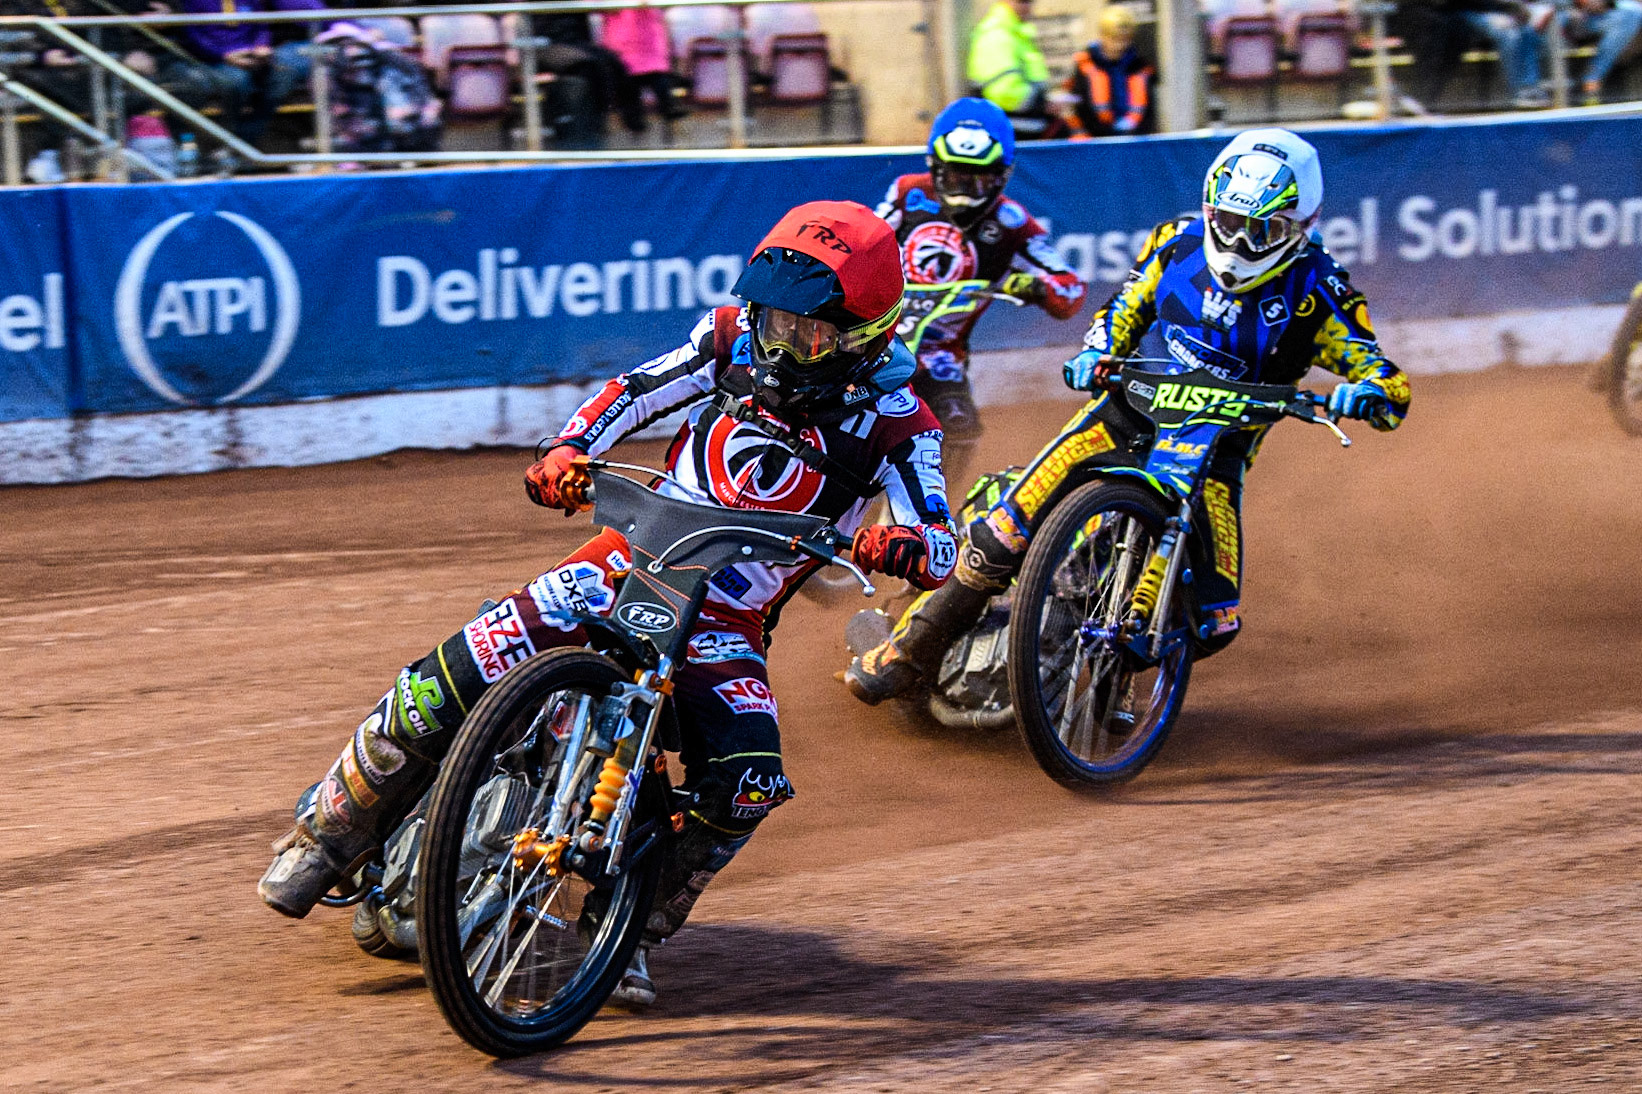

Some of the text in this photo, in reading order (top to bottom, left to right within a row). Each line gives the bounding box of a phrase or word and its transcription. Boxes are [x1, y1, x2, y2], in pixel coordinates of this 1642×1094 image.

[796, 219, 853, 255] FRP
[148, 277, 267, 339] ATPI
[1265, 302, 1284, 319] 5
[1153, 383, 1251, 418] RUSTY
[627, 604, 671, 626] FRP
[468, 620, 504, 679] SHORING
[400, 666, 430, 735] ROCK OIL
